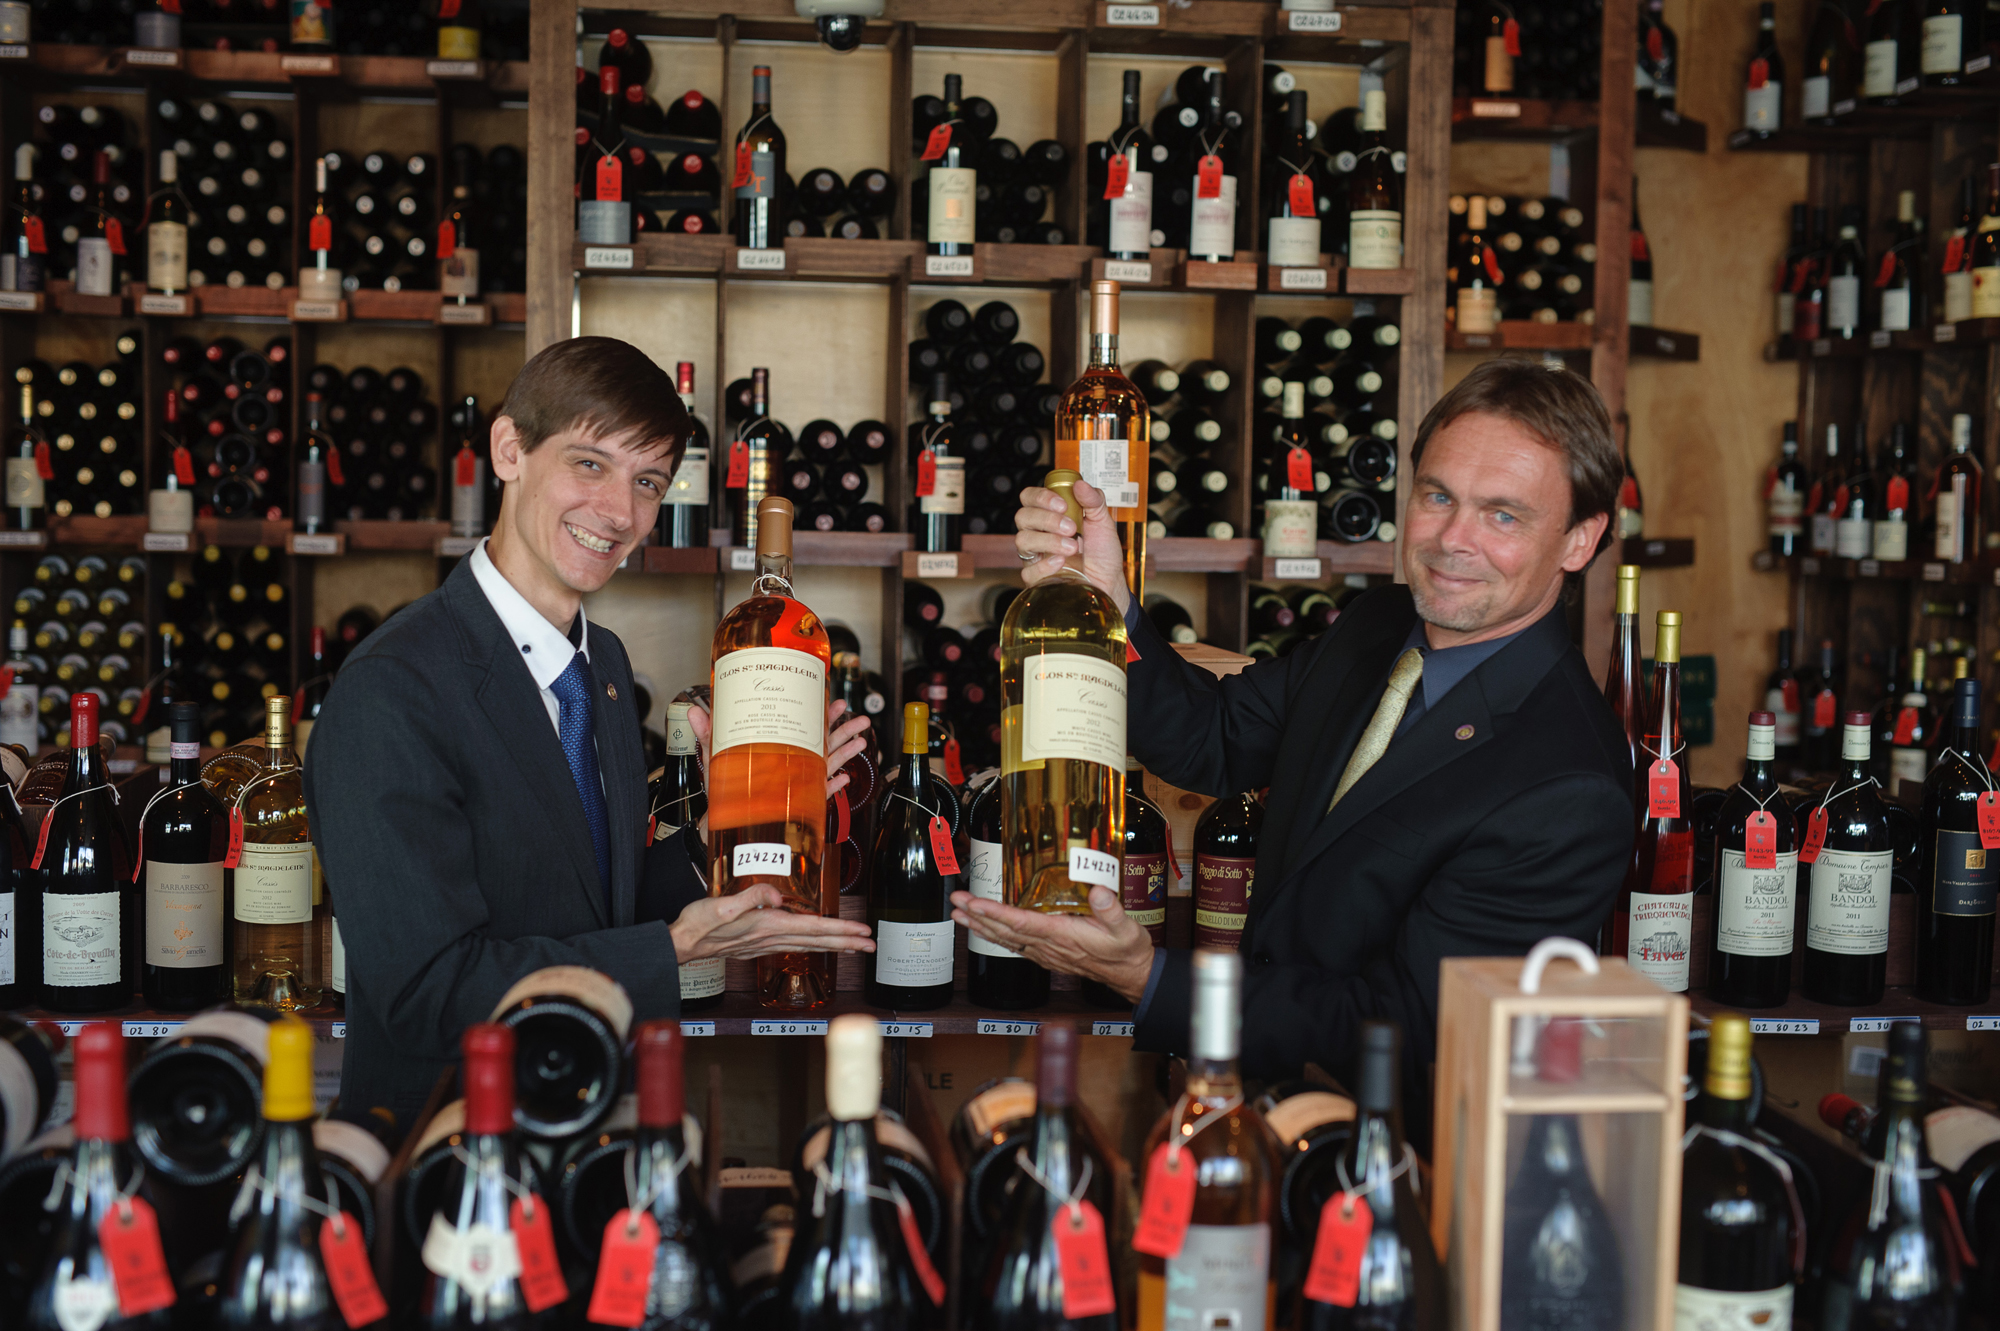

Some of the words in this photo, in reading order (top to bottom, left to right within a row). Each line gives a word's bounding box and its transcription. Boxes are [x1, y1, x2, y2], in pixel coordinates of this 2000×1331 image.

[719, 667, 740, 680] CLOS
[1034, 671, 1063, 681] CLOS
[752, 677, 785, 692] Cassis
[1086, 718, 1100, 727] 2012
[1127, 863, 1145, 876] Sotto
[1818, 854, 1858, 870] Domaine
[1860, 858, 1889, 874] Tempier
[1199, 862, 1217, 880] Poggio
[1217, 866, 1225, 878] di
[1225, 867, 1243, 879] Sotto
[160, 883, 209, 891] BARBARESCO
[1744, 895, 1790, 905] BANDOL
[1830, 893, 1878, 904] BANDOL
[1197, 912, 1223, 925] BRUNELLO
[1223, 918, 1230, 926] DI
[46, 947, 116, 960] Côte-de-Brouilly
[758, 1023, 773, 1034] 02
[780, 1023, 797, 1033] 80
[805, 1023, 818, 1033] 14
[886, 1025, 900, 1035] 80
[908, 1025, 924, 1035] 15
[983, 1023, 997, 1033] 02
[1005, 1024, 1022, 1034] 80
[1098, 1024, 1112, 1035] 02
[1755, 1023, 1768, 1032] 02
[1776, 1023, 1789, 1032] 80
[1794, 1023, 1808, 1032] 23
[1856, 1022, 1870, 1031] 02
[1877, 1022, 1890, 1031] 80
[1972, 1020, 1984, 1029] 02
[129, 1026, 144, 1036] 02
[151, 1026, 169, 1036] 80
[692, 1026, 704, 1035] 13
[924, 1072, 954, 1090] LE
